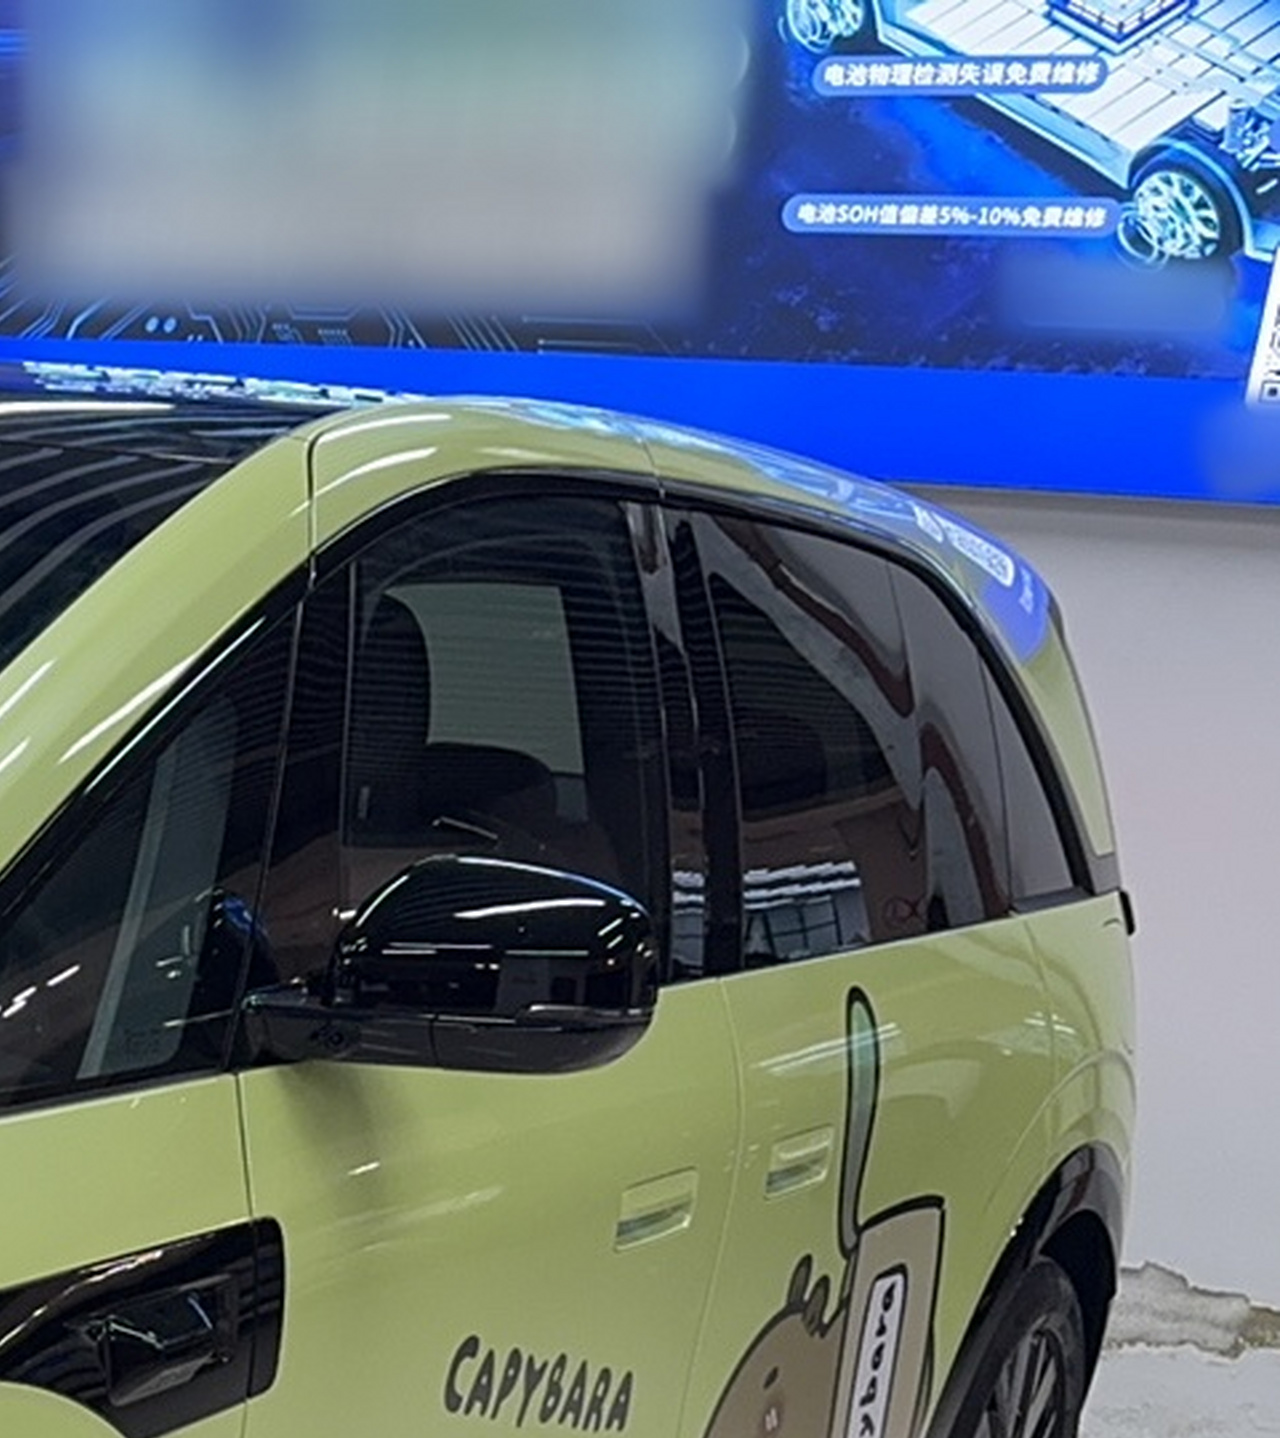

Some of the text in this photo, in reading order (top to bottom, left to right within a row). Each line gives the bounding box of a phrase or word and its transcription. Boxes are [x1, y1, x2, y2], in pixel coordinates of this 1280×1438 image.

[823, 61, 1100, 87] 电池物理检测失误免费维修
[443, 1334, 634, 1433] CAPYBARA
